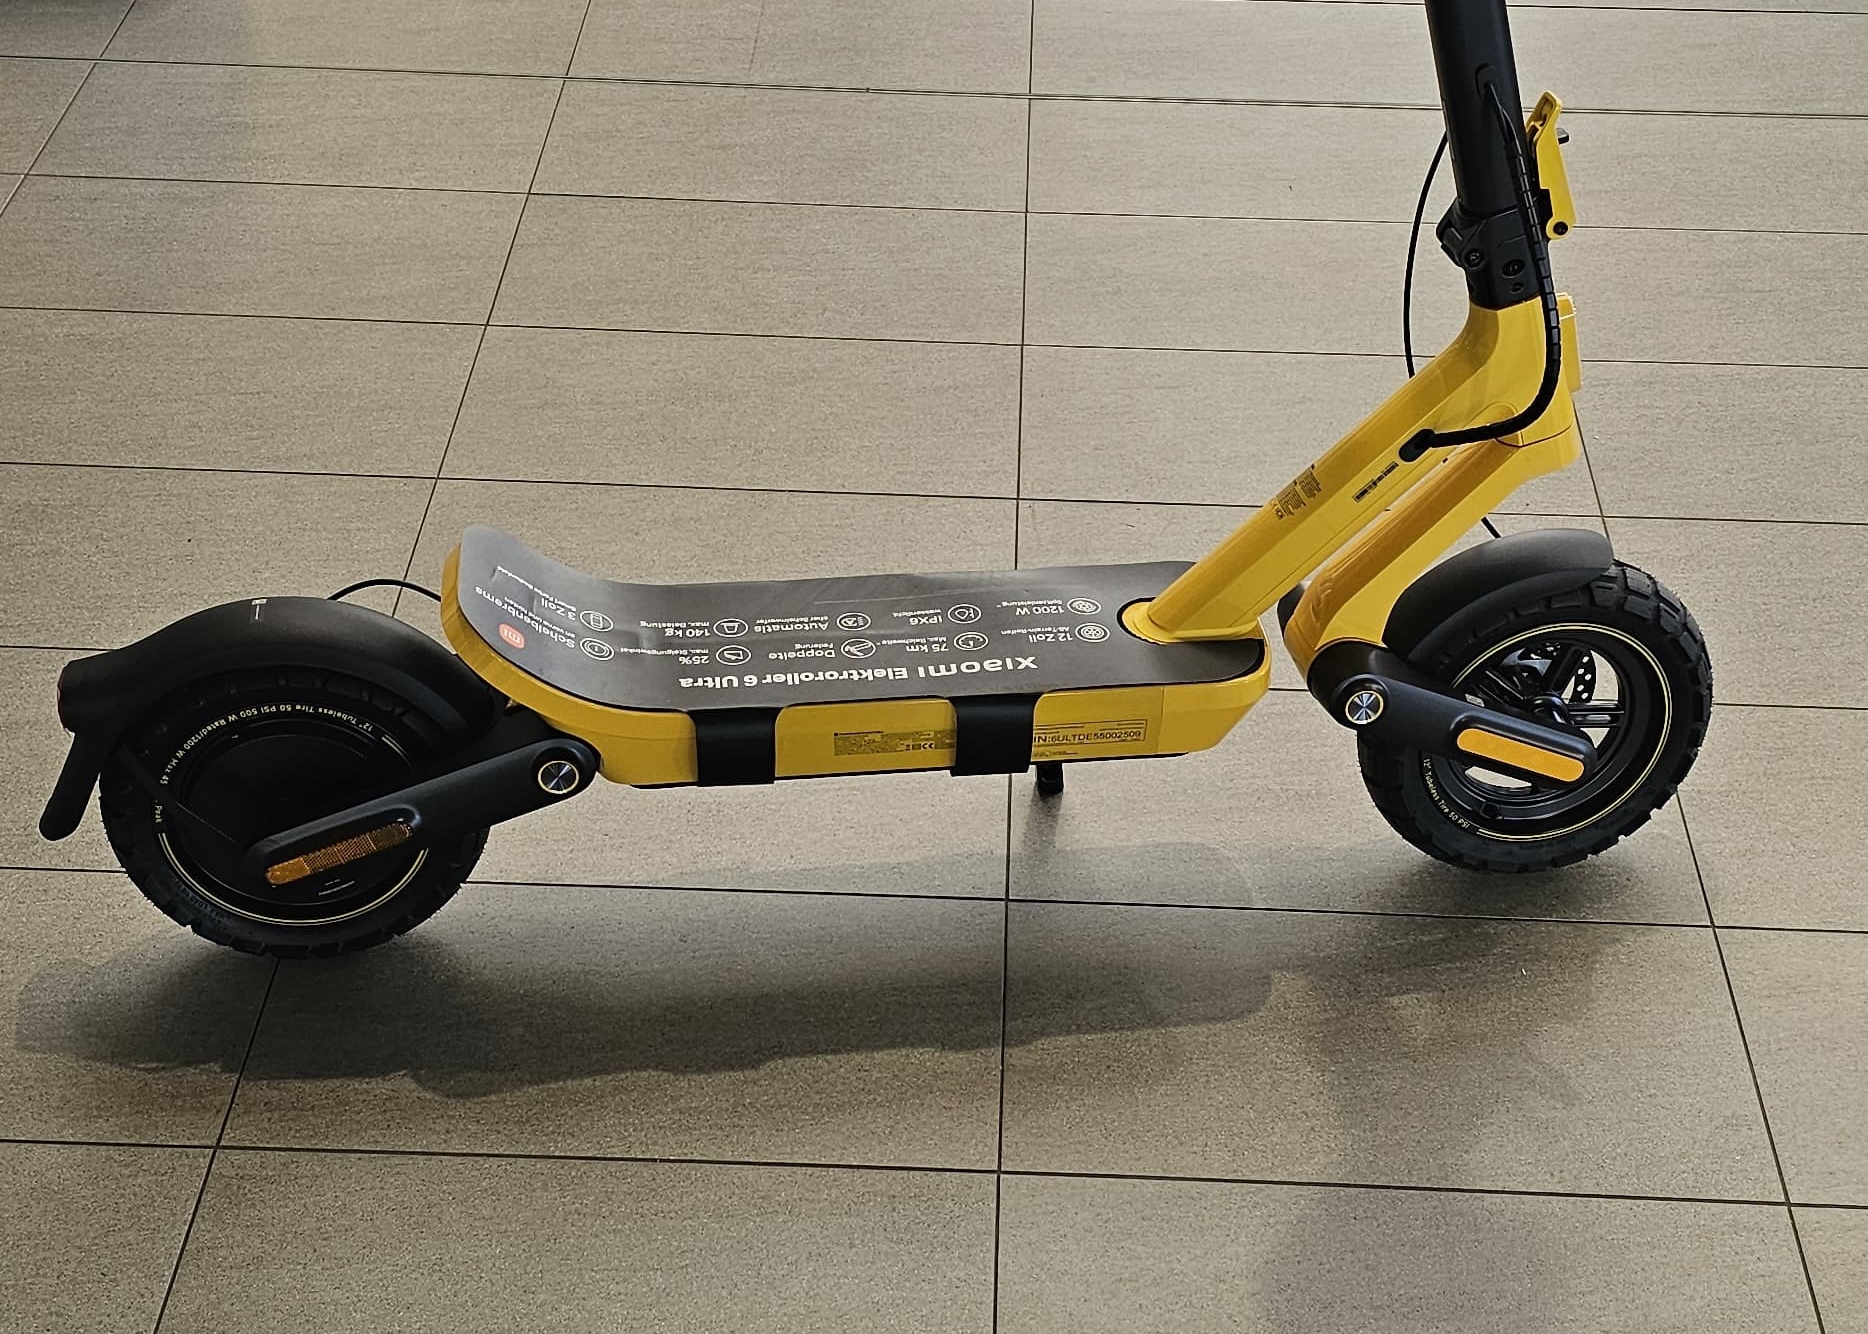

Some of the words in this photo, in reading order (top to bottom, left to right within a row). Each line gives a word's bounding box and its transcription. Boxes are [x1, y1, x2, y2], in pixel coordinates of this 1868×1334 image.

[540, 597, 566, 617] Zoll
[1015, 607, 1031, 616] W
[1032, 605, 1065, 615] 1200
[566, 610, 577, 621] 3
[909, 615, 943, 626] IPX6
[664, 627, 683, 638] kg
[685, 628, 711, 638] 140
[1058, 632, 1073, 642] 12
[1028, 633, 1056, 643] Zoll
[905, 644, 929, 653] km
[931, 643, 949, 652] 75
[678, 655, 710, 665] 25%
[768, 649, 836, 661] Doppelte
[743, 674, 758, 687] 6
[761, 667, 909, 686] Elektroroller
[679, 675, 739, 689] Ultra
[260, 705, 277, 714] PSI
[279, 703, 292, 712] 50
[240, 708, 258, 718] 500
[228, 714, 239, 723] W
[1033, 730, 1142, 744] IN:6ULTDE55002509
[175, 749, 186, 759] W
[1448, 811, 1459, 821] 50
[1457, 818, 1471, 829] PSI
